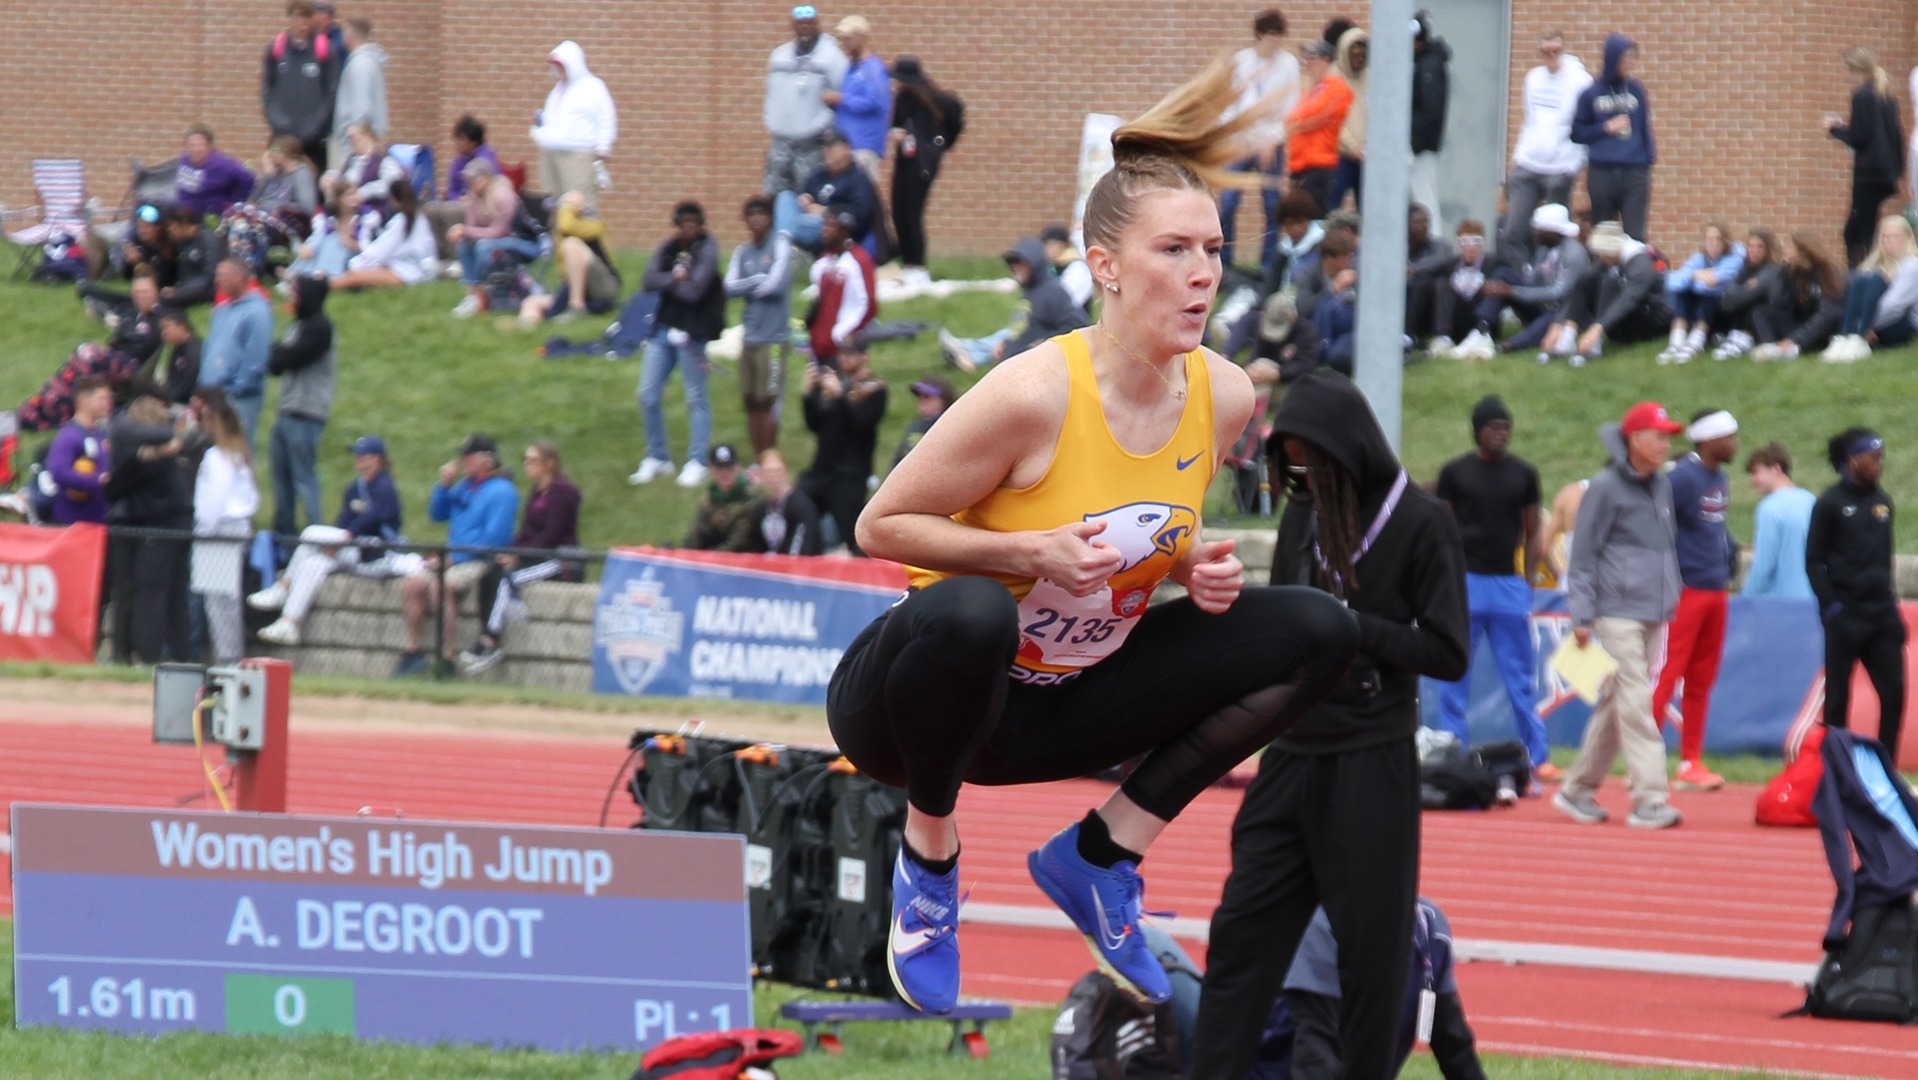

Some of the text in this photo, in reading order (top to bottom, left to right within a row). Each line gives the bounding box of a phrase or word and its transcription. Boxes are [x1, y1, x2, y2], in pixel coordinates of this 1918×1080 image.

[693, 595, 818, 640] NATIONAL
[1024, 607, 1123, 644] 2135
[151, 821, 613, 896] Women's High Jump
[226, 896, 544, 959] A. DEGROOT
[48, 976, 196, 1020] 1.61m
[275, 985, 306, 1027] 0
